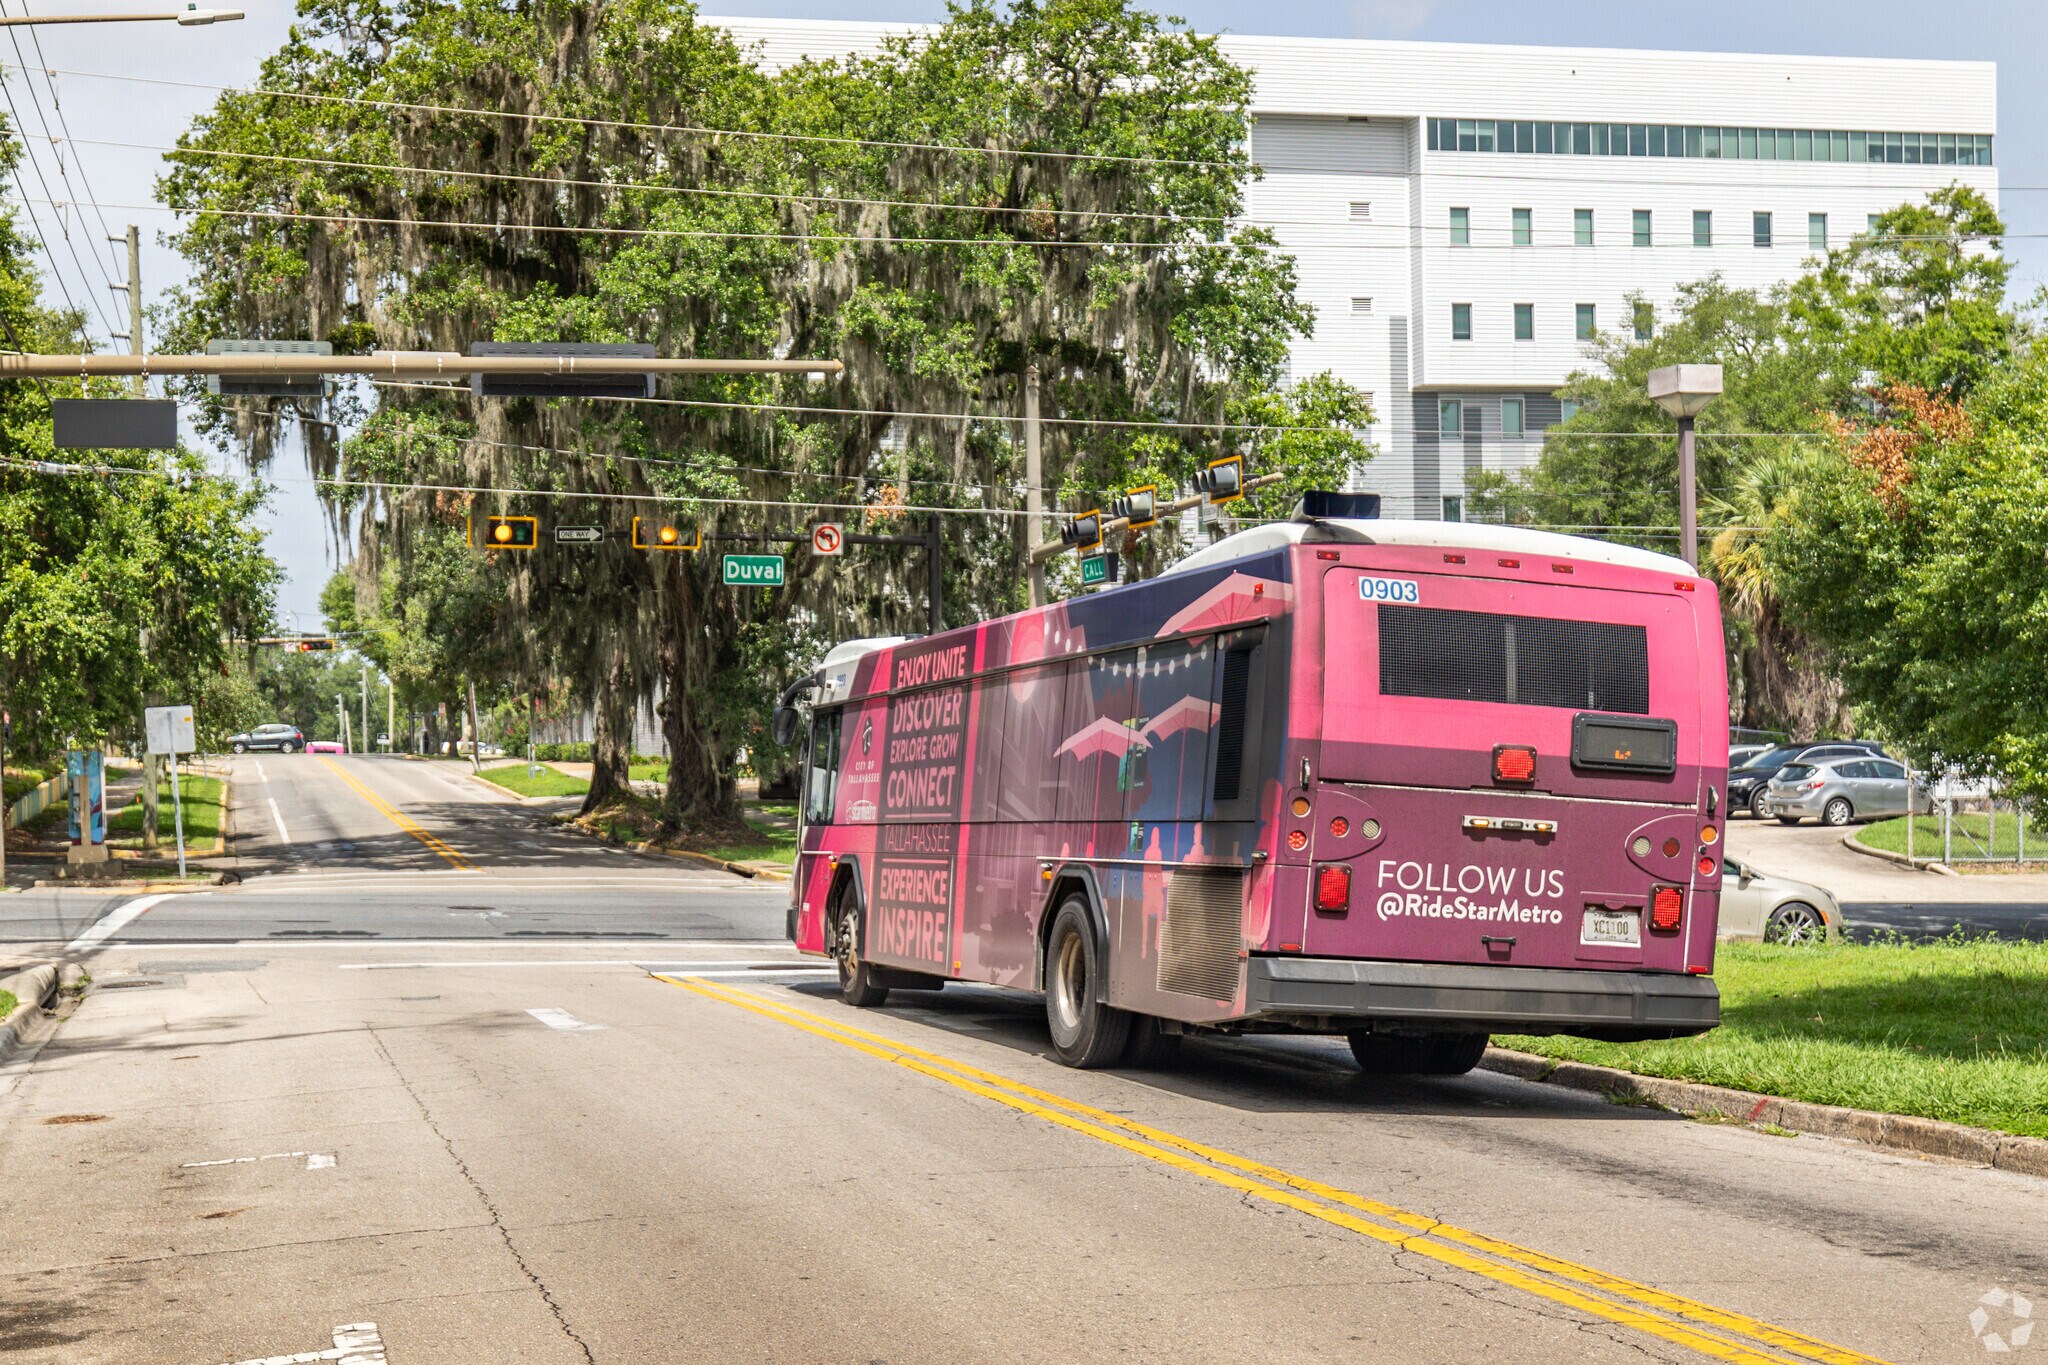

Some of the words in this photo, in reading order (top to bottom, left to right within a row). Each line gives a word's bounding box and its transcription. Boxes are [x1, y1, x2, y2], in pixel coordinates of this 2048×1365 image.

[727, 561, 780, 579] Duval
[1084, 562, 1104, 578] CALL
[1361, 578, 1418, 602] 0903
[897, 653, 932, 688] ENJOY
[932, 645, 967, 682] UNITE
[892, 686, 963, 734] DISCOVER
[890, 735, 928, 764] EXPLORE
[929, 732, 959, 760] GROW
[848, 772, 880, 784] TALLAHASSEE
[855, 761, 866, 771] CITY
[867, 760, 875, 770] OF
[887, 766, 956, 808] CONNECT
[884, 823, 951, 852] TALLAHASSEE
[880, 868, 948, 905] EXPERIENCE
[1377, 859, 1517, 896] FOLLOW
[1523, 868, 1565, 899] US
[1376, 891, 1563, 925] @RideStarMetro
[877, 906, 945, 962] INSPIRE
